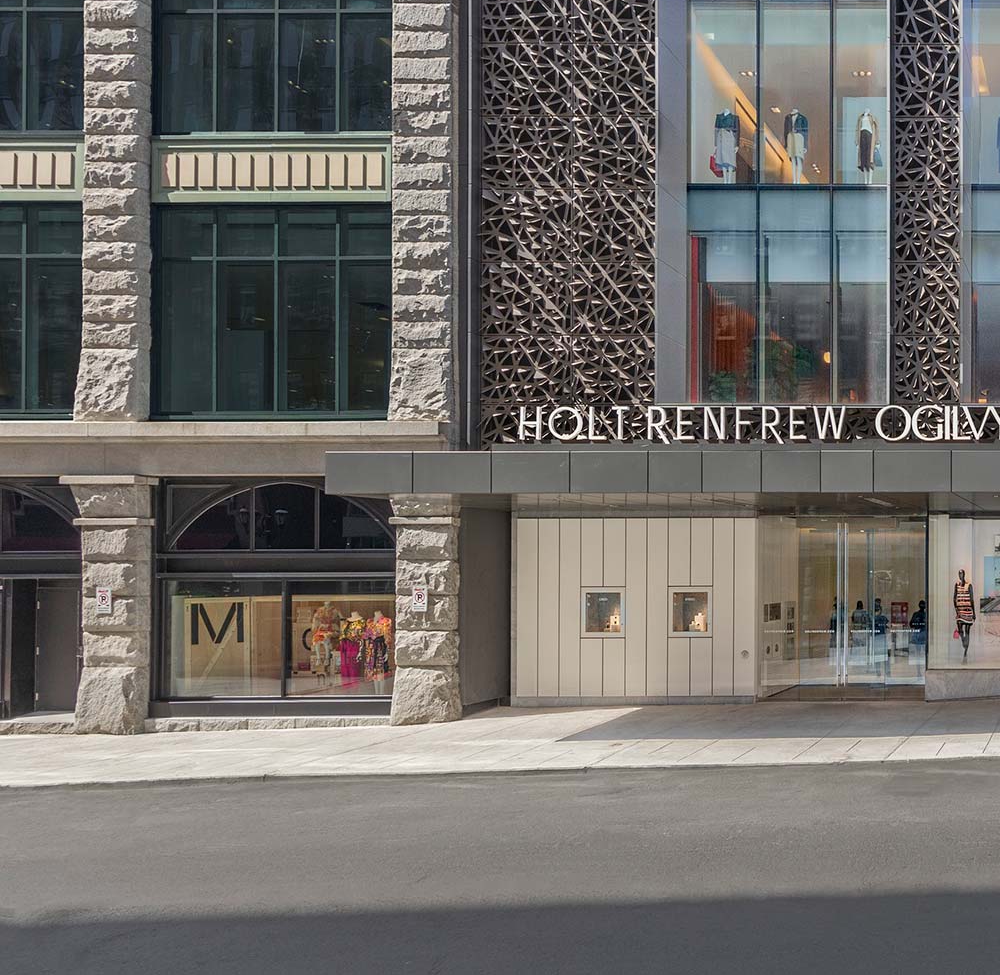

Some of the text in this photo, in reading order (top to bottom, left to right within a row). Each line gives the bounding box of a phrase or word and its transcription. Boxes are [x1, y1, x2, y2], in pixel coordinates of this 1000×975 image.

[519, 406, 630, 440] HOLT
[647, 405, 847, 444] RENFREW
[191, 602, 244, 645] M
